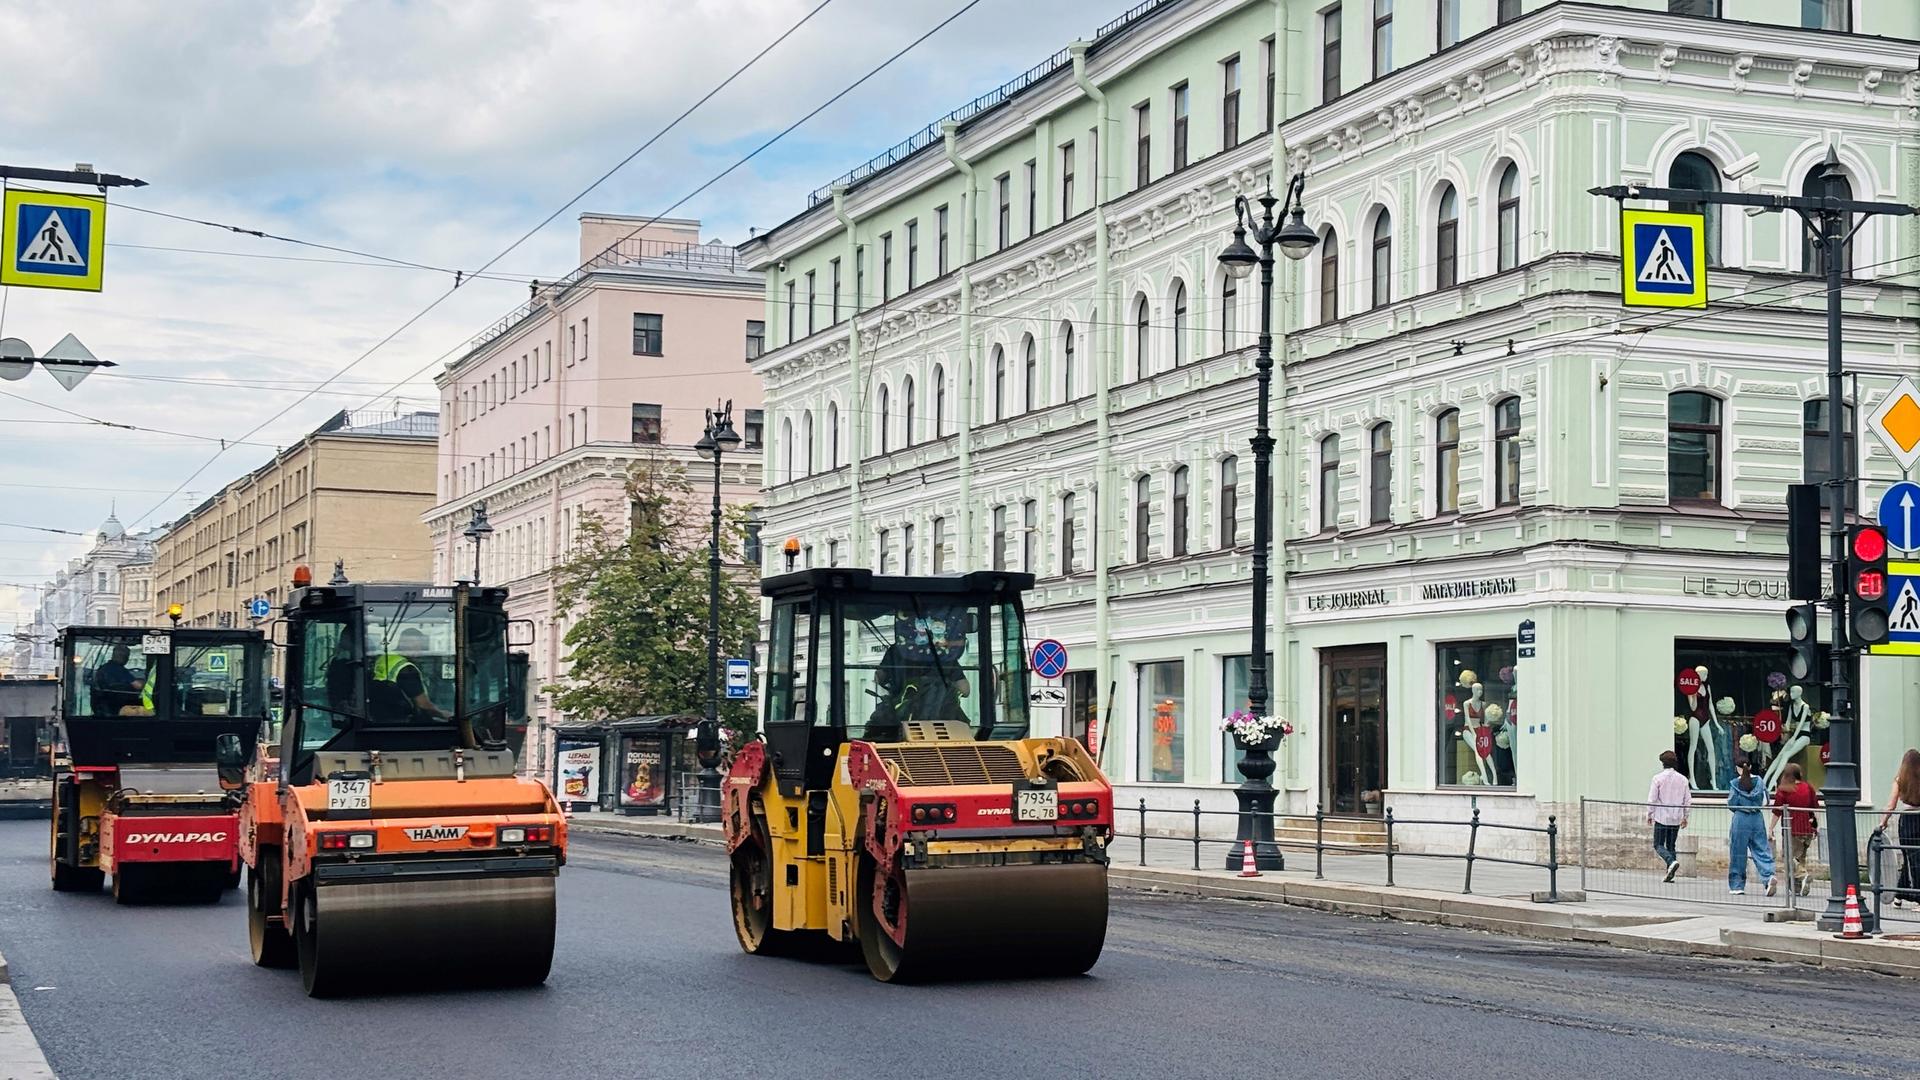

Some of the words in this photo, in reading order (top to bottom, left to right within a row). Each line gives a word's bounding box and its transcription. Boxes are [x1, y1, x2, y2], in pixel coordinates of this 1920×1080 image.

[1422, 580, 1476, 600] МАГАЗИН
[1480, 577, 1517, 597] БЕЛЬЯ
[1683, 575, 1717, 596] LE
[1858, 573, 1882, 596] 20
[1308, 595, 1325, 611] LE
[1327, 589, 1390, 610] JOURNAL
[1680, 678, 1699, 686] SALE
[1755, 720, 1776, 732] -50
[1477, 736, 1489, 747] -50
[334, 781, 366, 794] 1347
[331, 798, 347, 808] РУ
[354, 798, 367, 808] 78
[1023, 792, 1053, 805] 7934
[977, 808, 1013, 816] DYNA
[1021, 808, 1037, 818] РС
[1043, 808, 1055, 818] 78
[125, 832, 228, 844] DYNAPAC
[413, 827, 459, 840] HAMM
